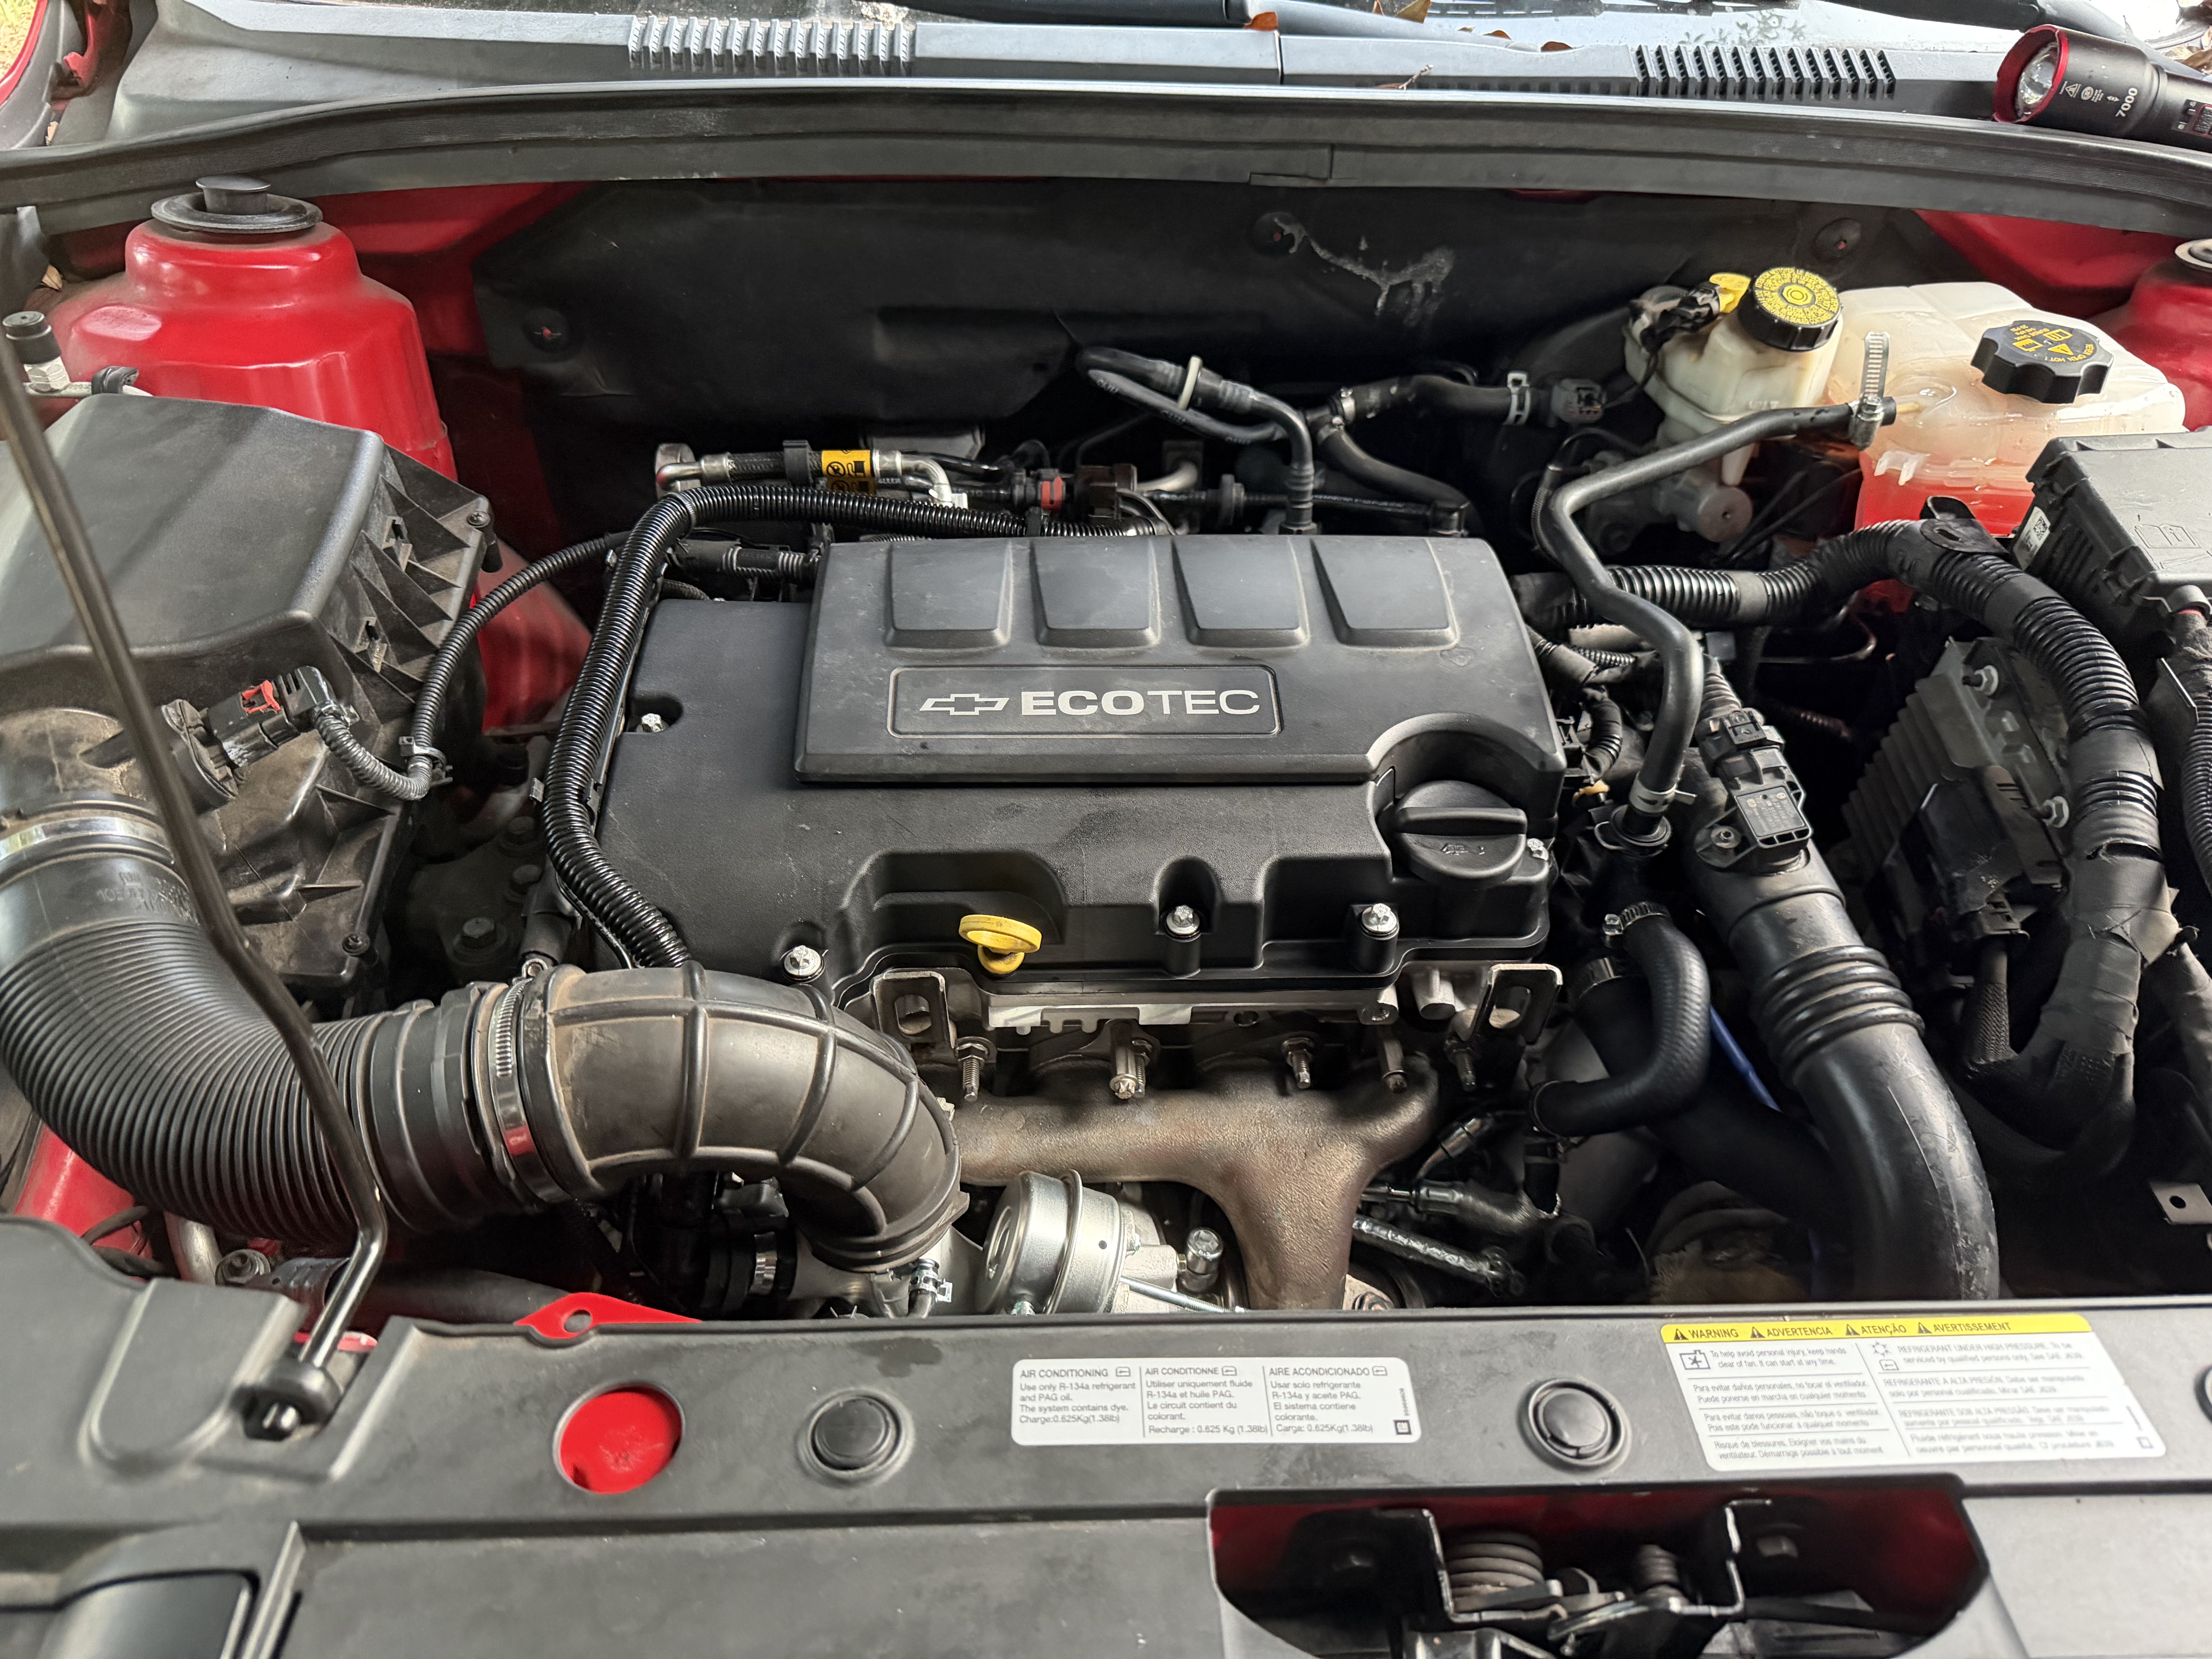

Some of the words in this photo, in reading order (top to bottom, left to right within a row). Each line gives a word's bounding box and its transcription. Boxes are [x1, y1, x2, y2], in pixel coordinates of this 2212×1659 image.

[2115, 88, 2138, 117] 7000
[1021, 690, 1260, 715] ECOTEC
[1767, 1327, 1833, 1336] ADVERTENCIA
[1861, 1323, 1906, 1336] ATENÇÃO
[1934, 1322, 2011, 1332] AVERTISSEMENT
[1689, 1328, 1739, 1339] WARNING
[1756, 1349, 1784, 1358] personal
[1020, 1370, 1036, 1378] AIR
[1039, 1369, 1108, 1378] CONDITIONING
[1269, 1367, 1290, 1376] AIRE
[1293, 1367, 1370, 1376] ACONDICIONADO
[1039, 1383, 1056, 1391] only
[1092, 1382, 1136, 1391] refrigerant
[1178, 1380, 1227, 1389] uniquement
[1313, 1381, 1361, 1389] refrigerante
[1039, 1393, 1058, 1401] PAG
[1060, 1393, 1073, 1401] oil.
[1039, 1405, 1069, 1413] system
[1111, 1404, 1128, 1412] dye.
[1147, 1401, 1158, 1410] Le
[1160, 1401, 1187, 1409] circuit
[1274, 1402, 1282, 1410] El
[1274, 1413, 1317, 1421] colorante.
[1149, 1425, 1190, 1434] Recharge
[1223, 1425, 1235, 1434] Kg
[1237, 1425, 1268, 1434] (1.38lb)
[1276, 1424, 1305, 1434] Carga:
